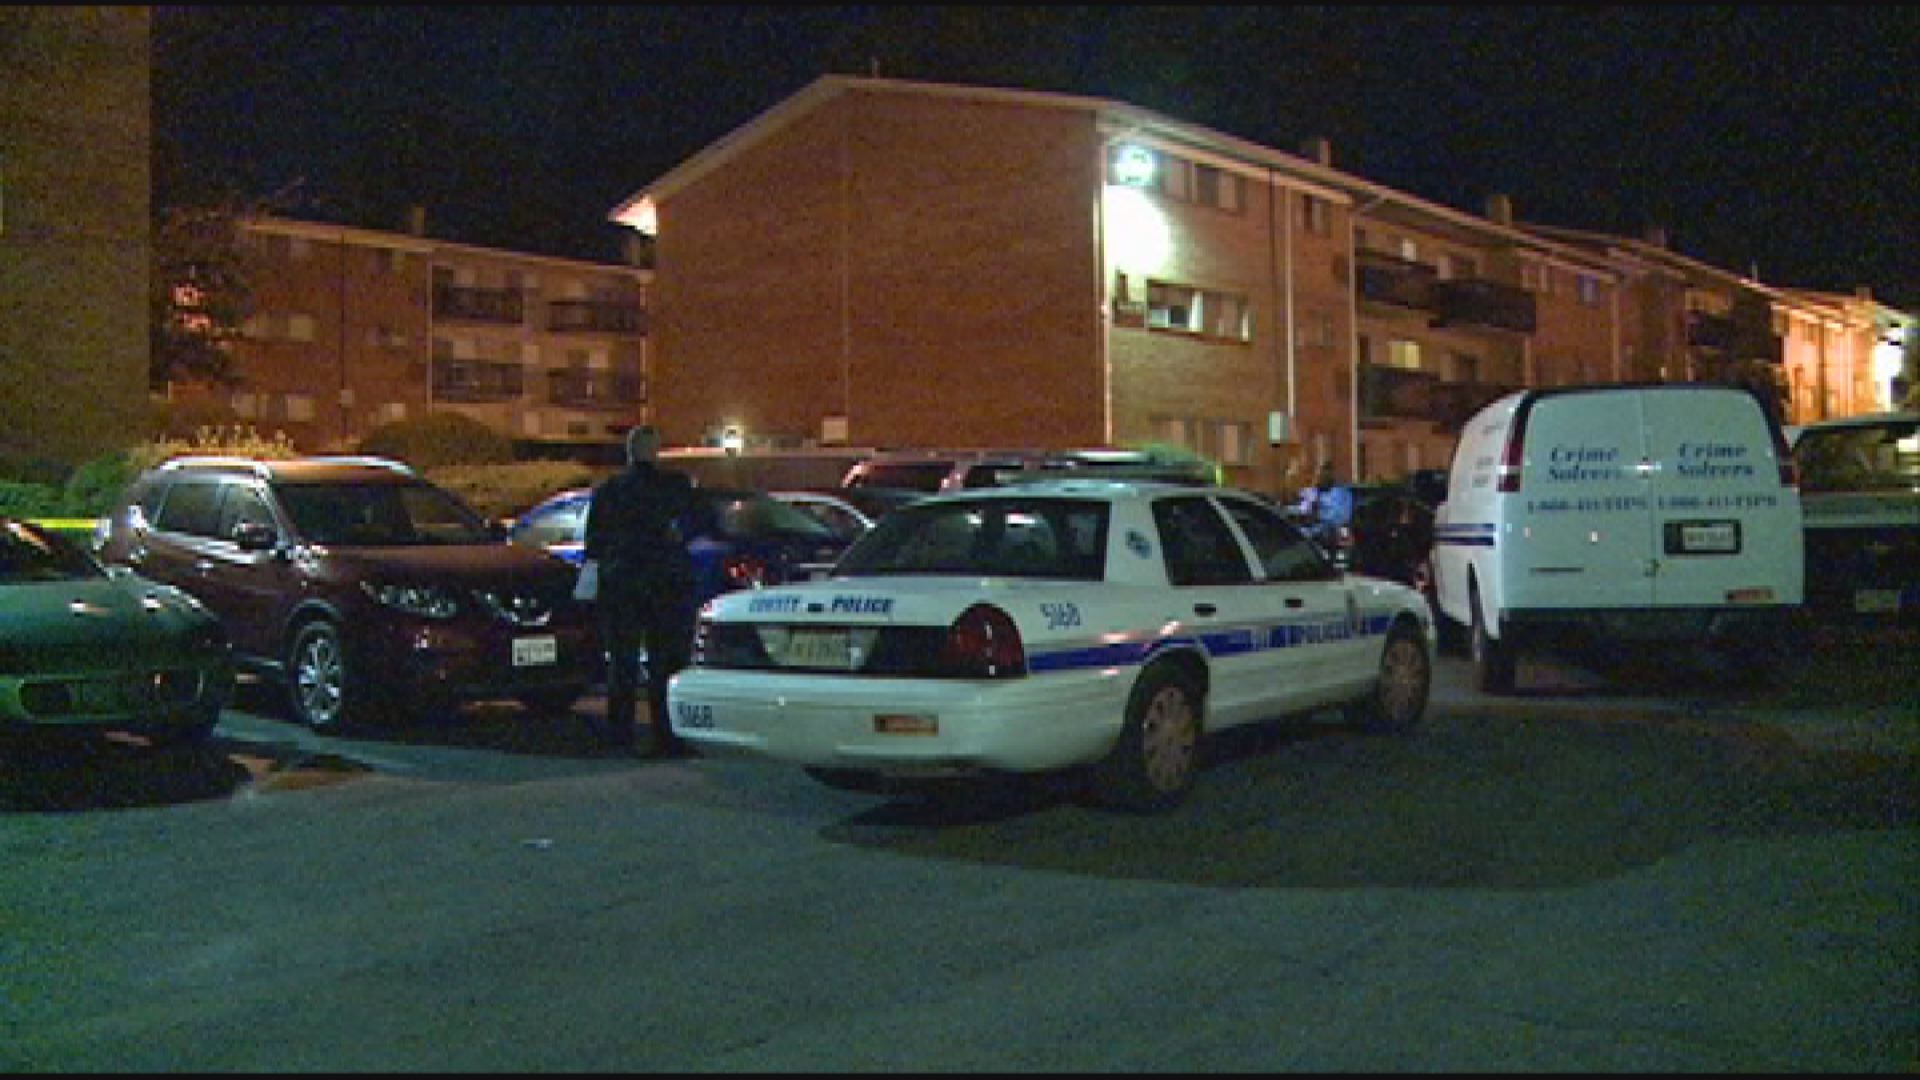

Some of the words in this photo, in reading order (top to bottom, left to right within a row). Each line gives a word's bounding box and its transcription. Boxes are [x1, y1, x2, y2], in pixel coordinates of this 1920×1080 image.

[1550, 443, 1619, 461] Crime
[1679, 441, 1747, 459] Crime
[832, 594, 894, 613] POLICE
